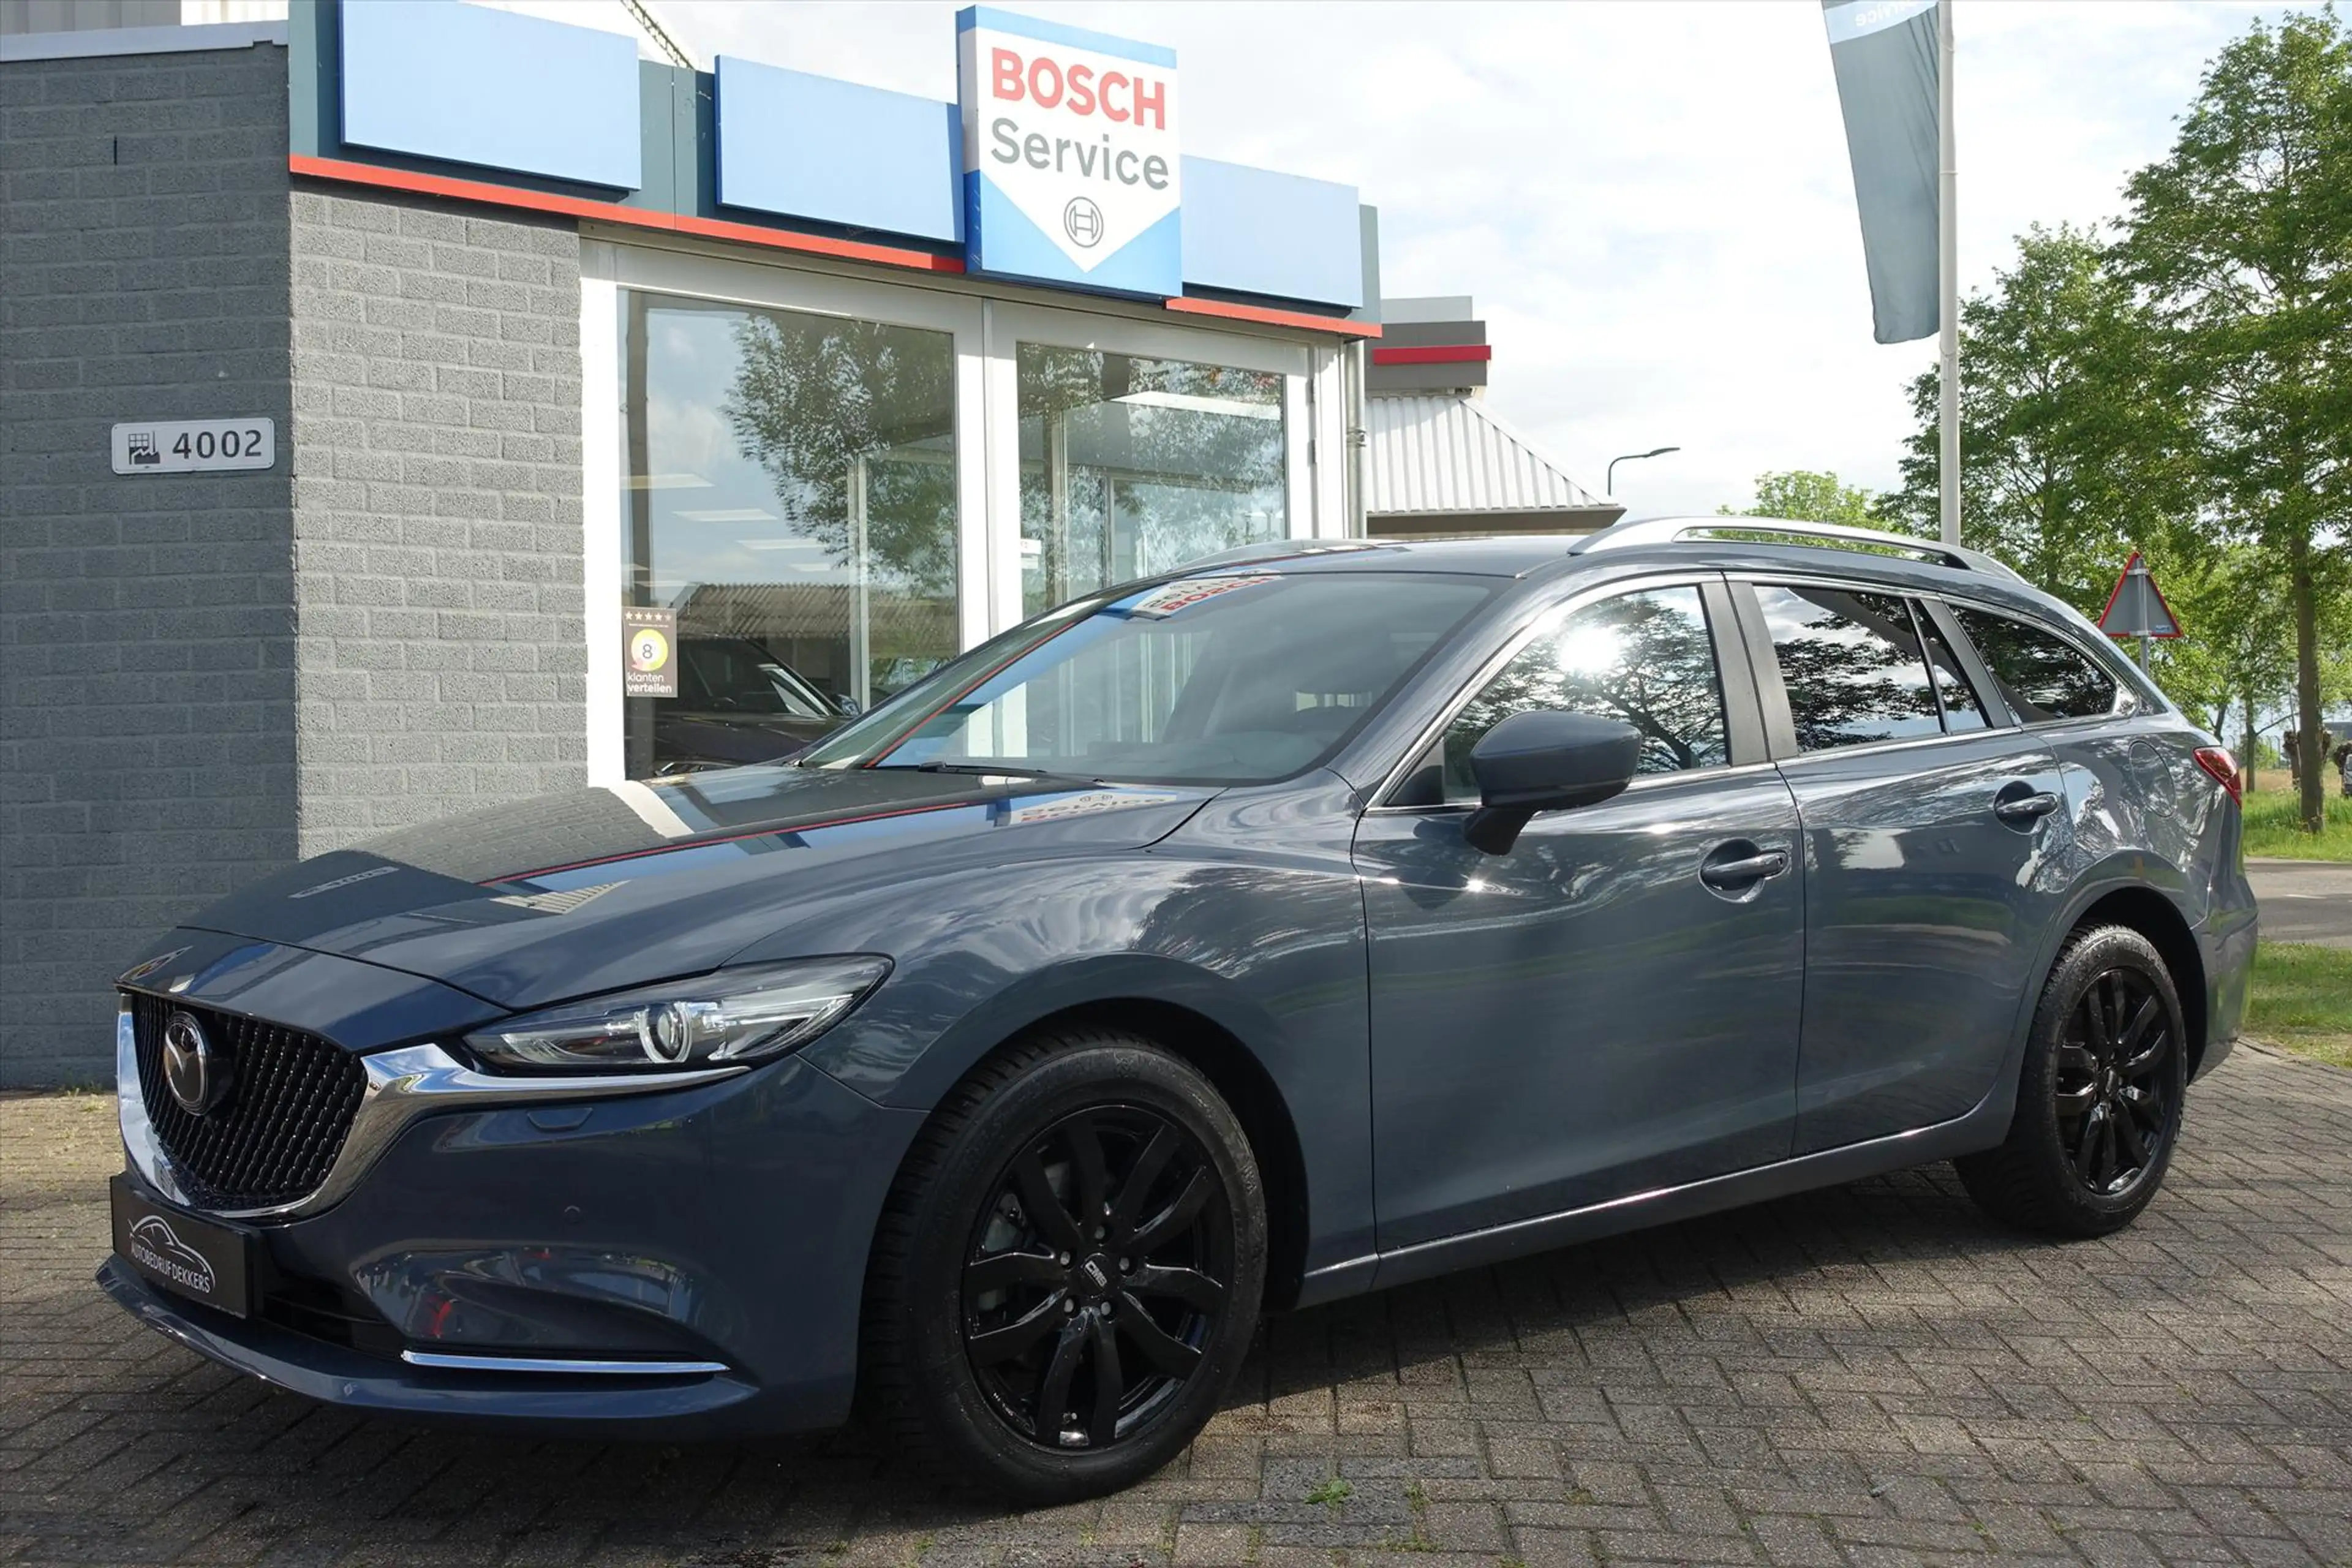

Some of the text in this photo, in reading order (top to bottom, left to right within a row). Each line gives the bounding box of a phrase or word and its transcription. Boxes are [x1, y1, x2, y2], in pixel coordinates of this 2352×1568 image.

[992, 47, 1165, 130] BOSCH
[992, 118, 1169, 190] Service
[172, 430, 262, 459] 4002
[643, 644, 653, 659] 8
[627, 672, 664, 682] klanten
[627, 683, 672, 693] vertellen
[132, 1241, 211, 1293] AUTOBEDRIJF DEKKERS
